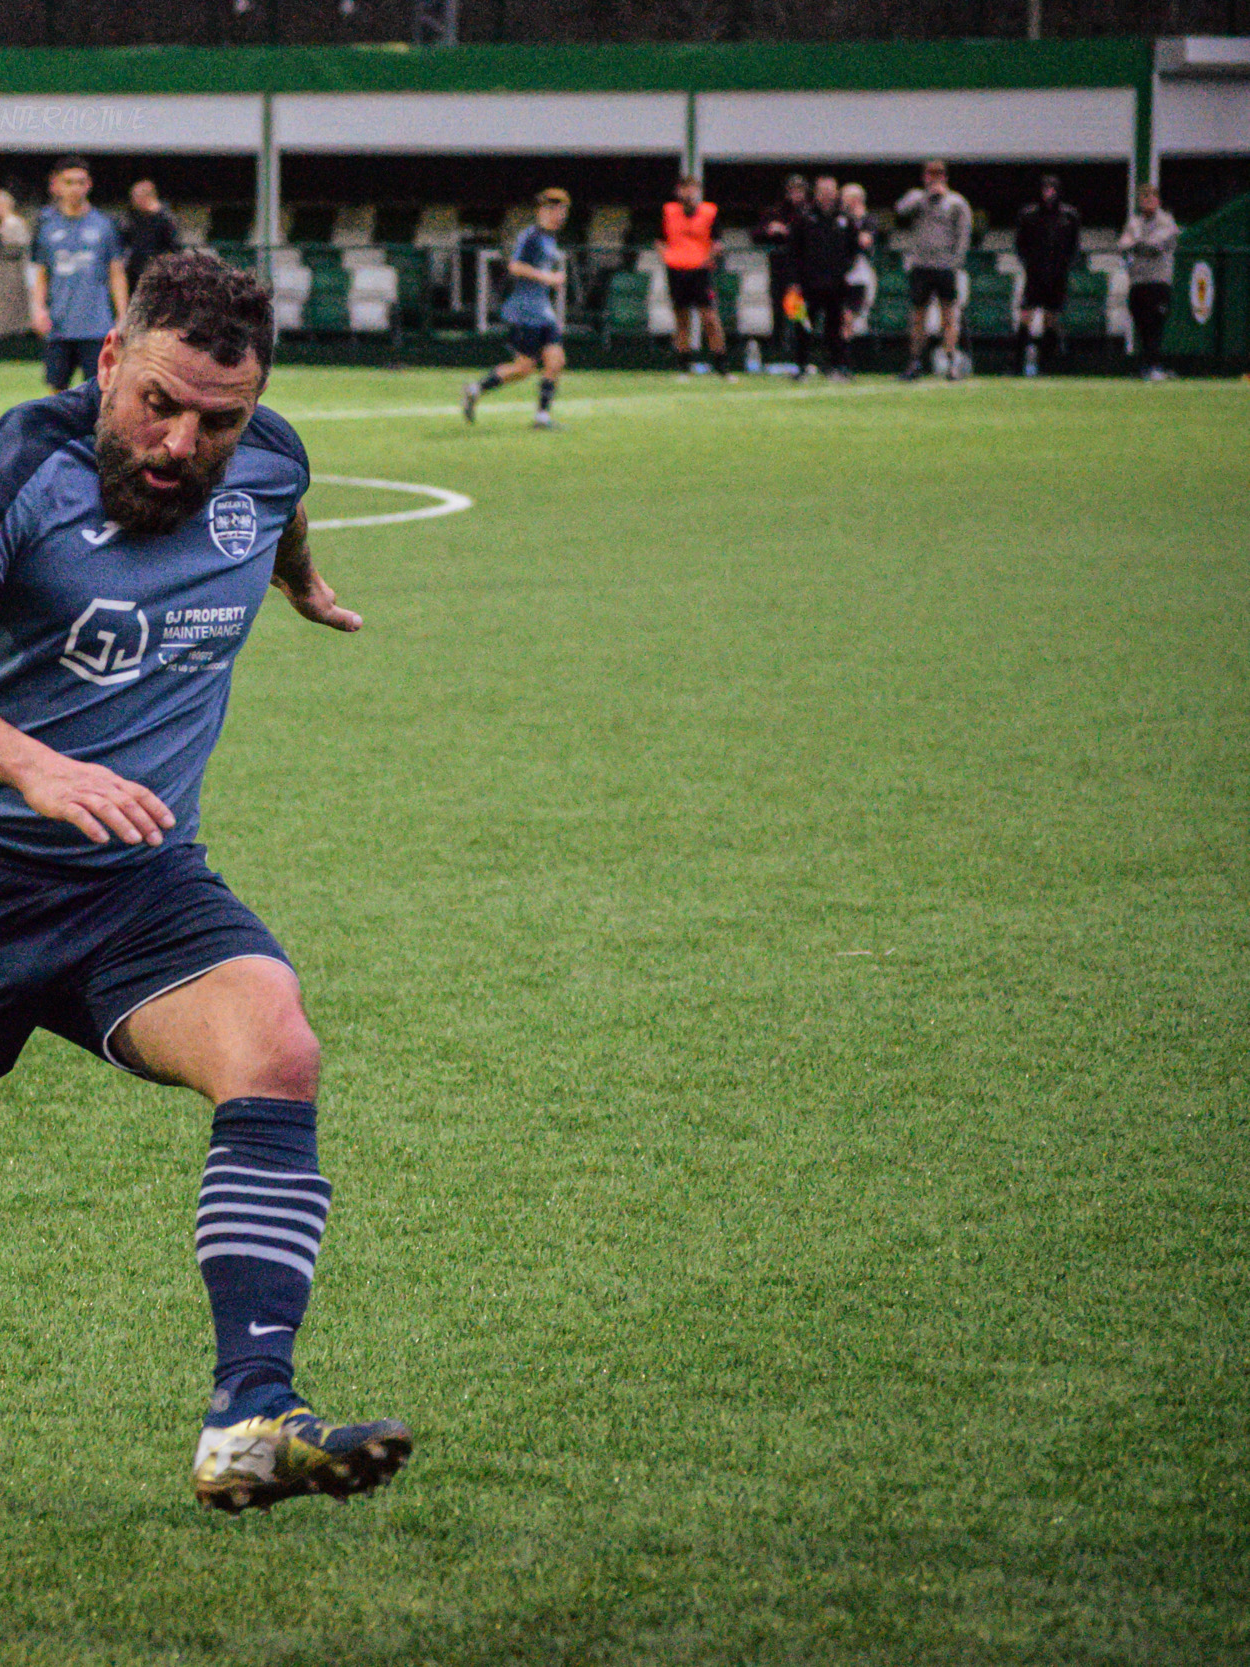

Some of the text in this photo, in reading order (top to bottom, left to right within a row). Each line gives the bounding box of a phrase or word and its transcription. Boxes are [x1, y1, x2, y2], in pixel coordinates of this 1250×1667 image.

[165, 606, 247, 625] GJ PROPERTY
[163, 623, 244, 640] MAINTENANCE
